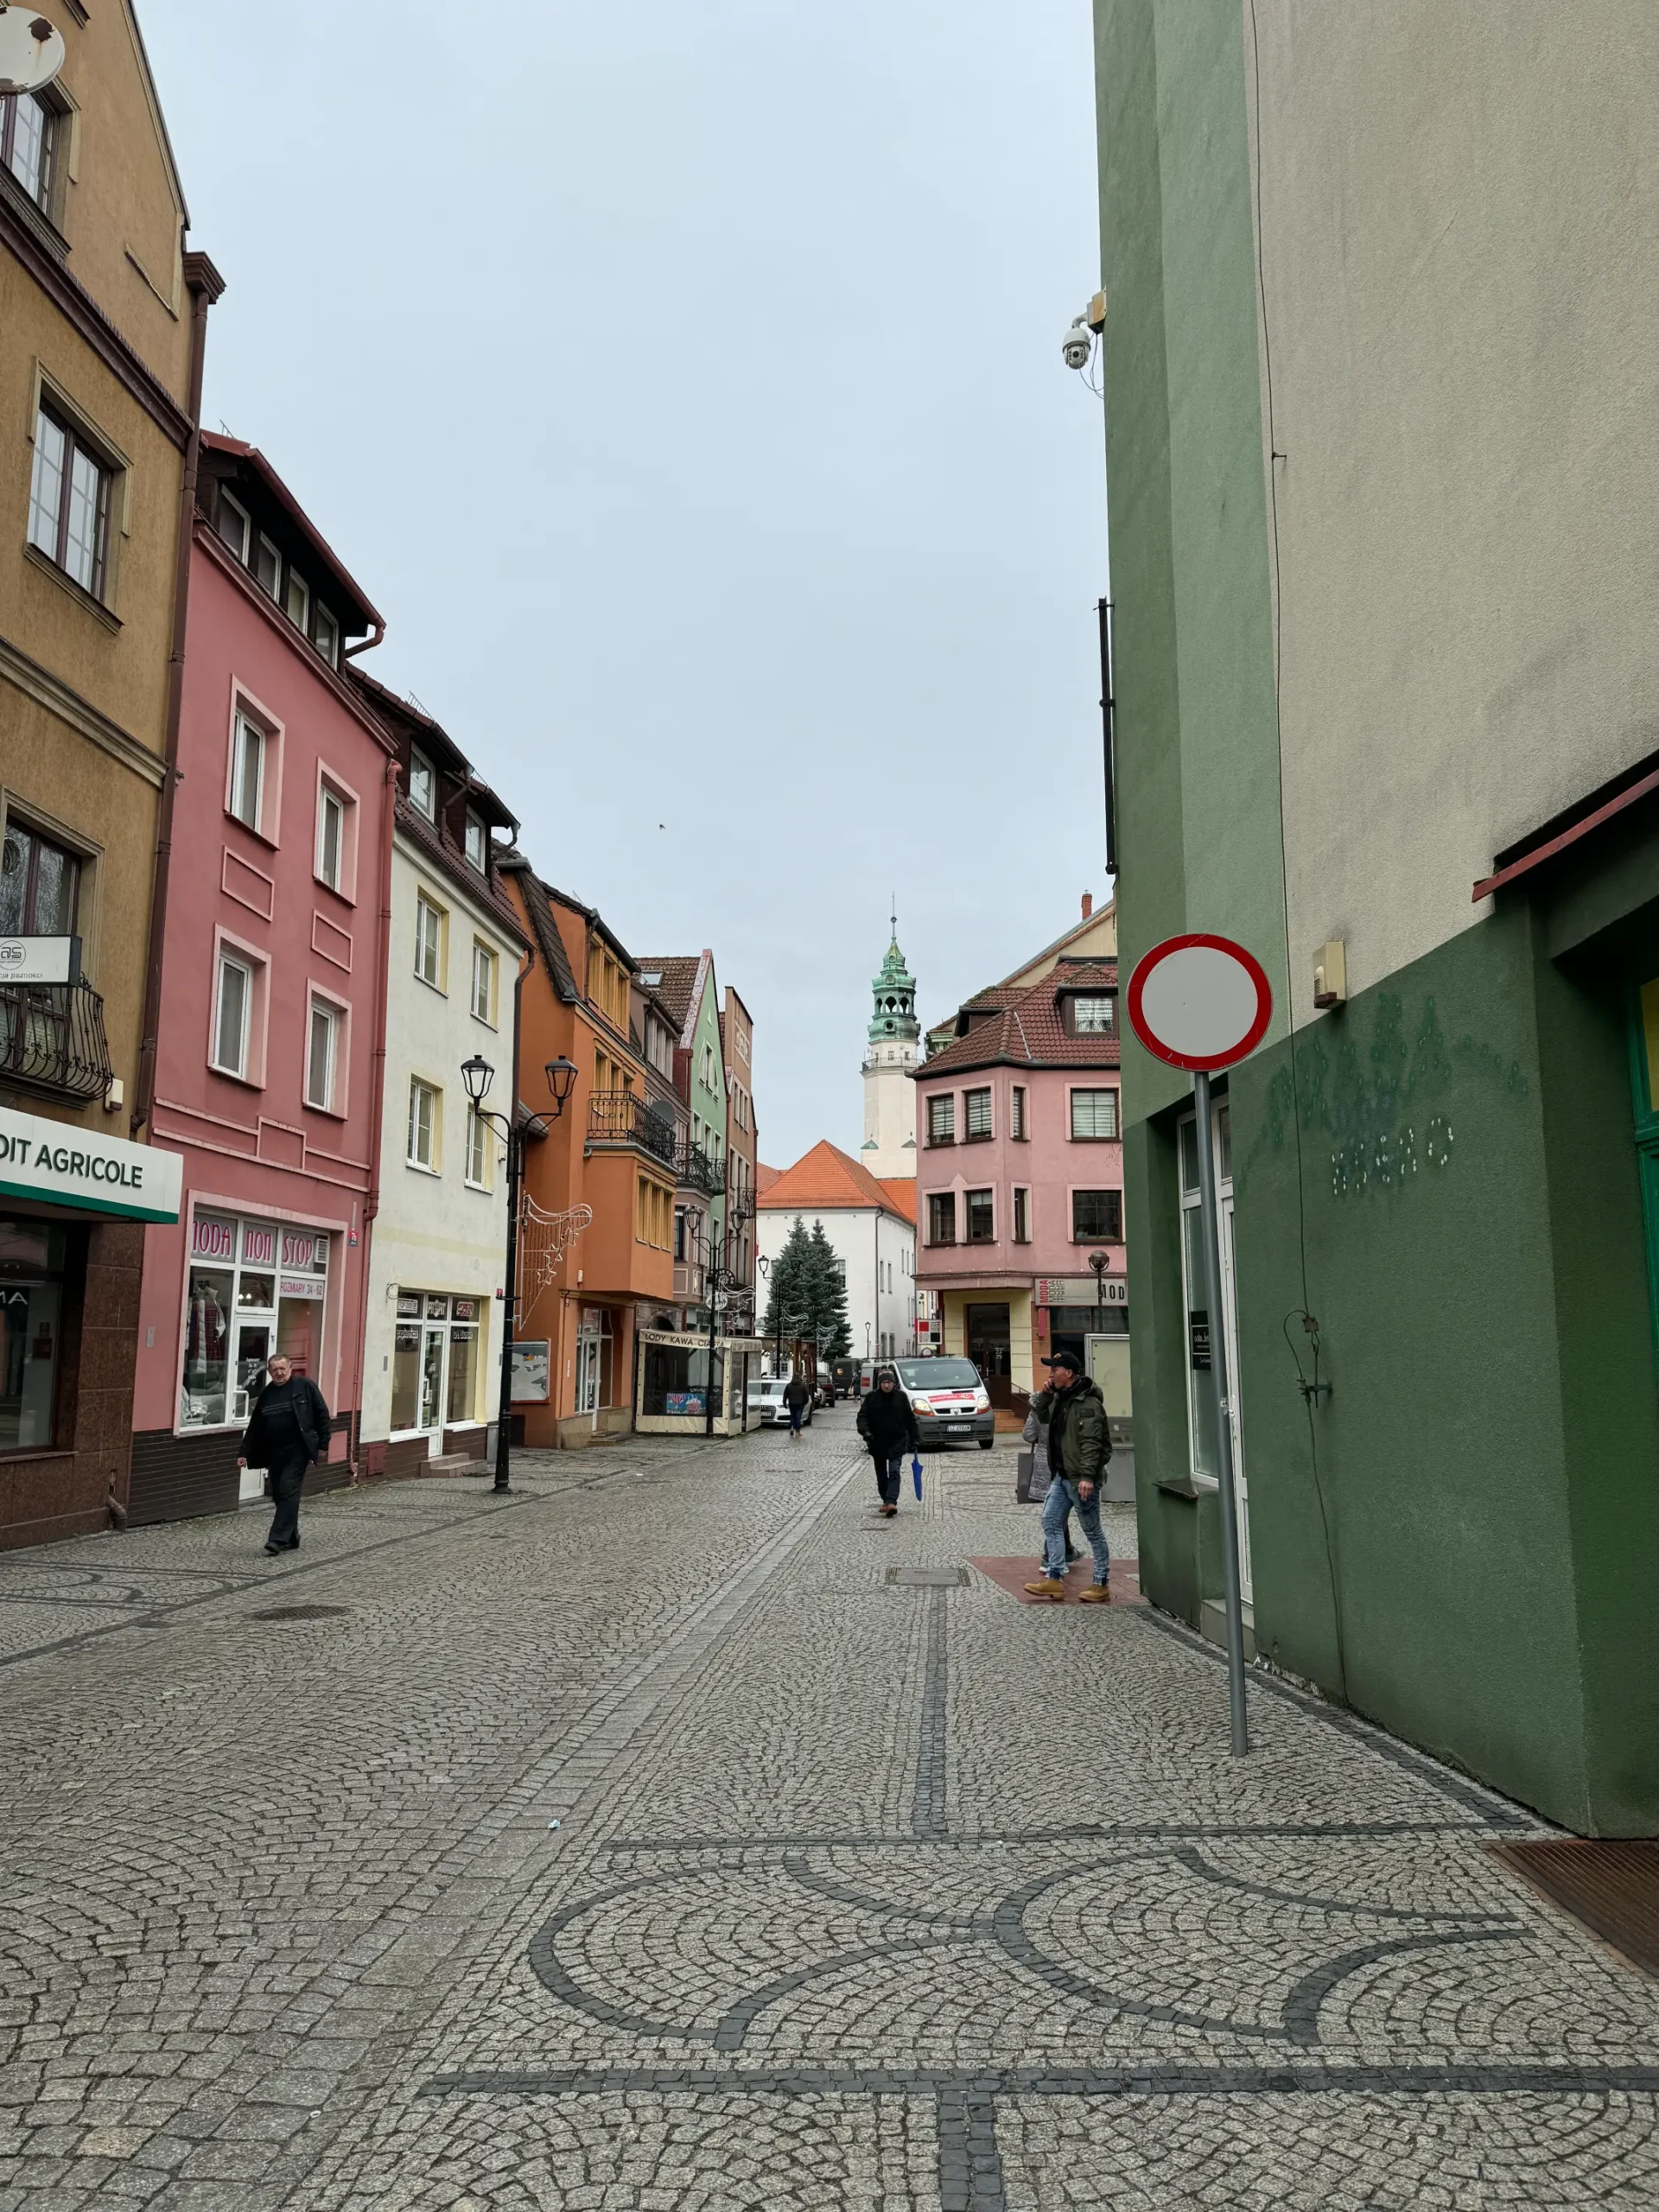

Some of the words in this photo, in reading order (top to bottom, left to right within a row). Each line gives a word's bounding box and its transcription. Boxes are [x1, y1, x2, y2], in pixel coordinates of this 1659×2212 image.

[10, 971, 43, 980] paznokci
[34, 1144, 143, 1189] AGRICOLE
[283, 1236, 313, 1268] STOP
[280, 1281, 305, 1294] ROZMIARY
[307, 1284, 313, 1294] 34
[1039, 1280, 1049, 1303] MODA
[670, 1336, 694, 1345] KAWA
